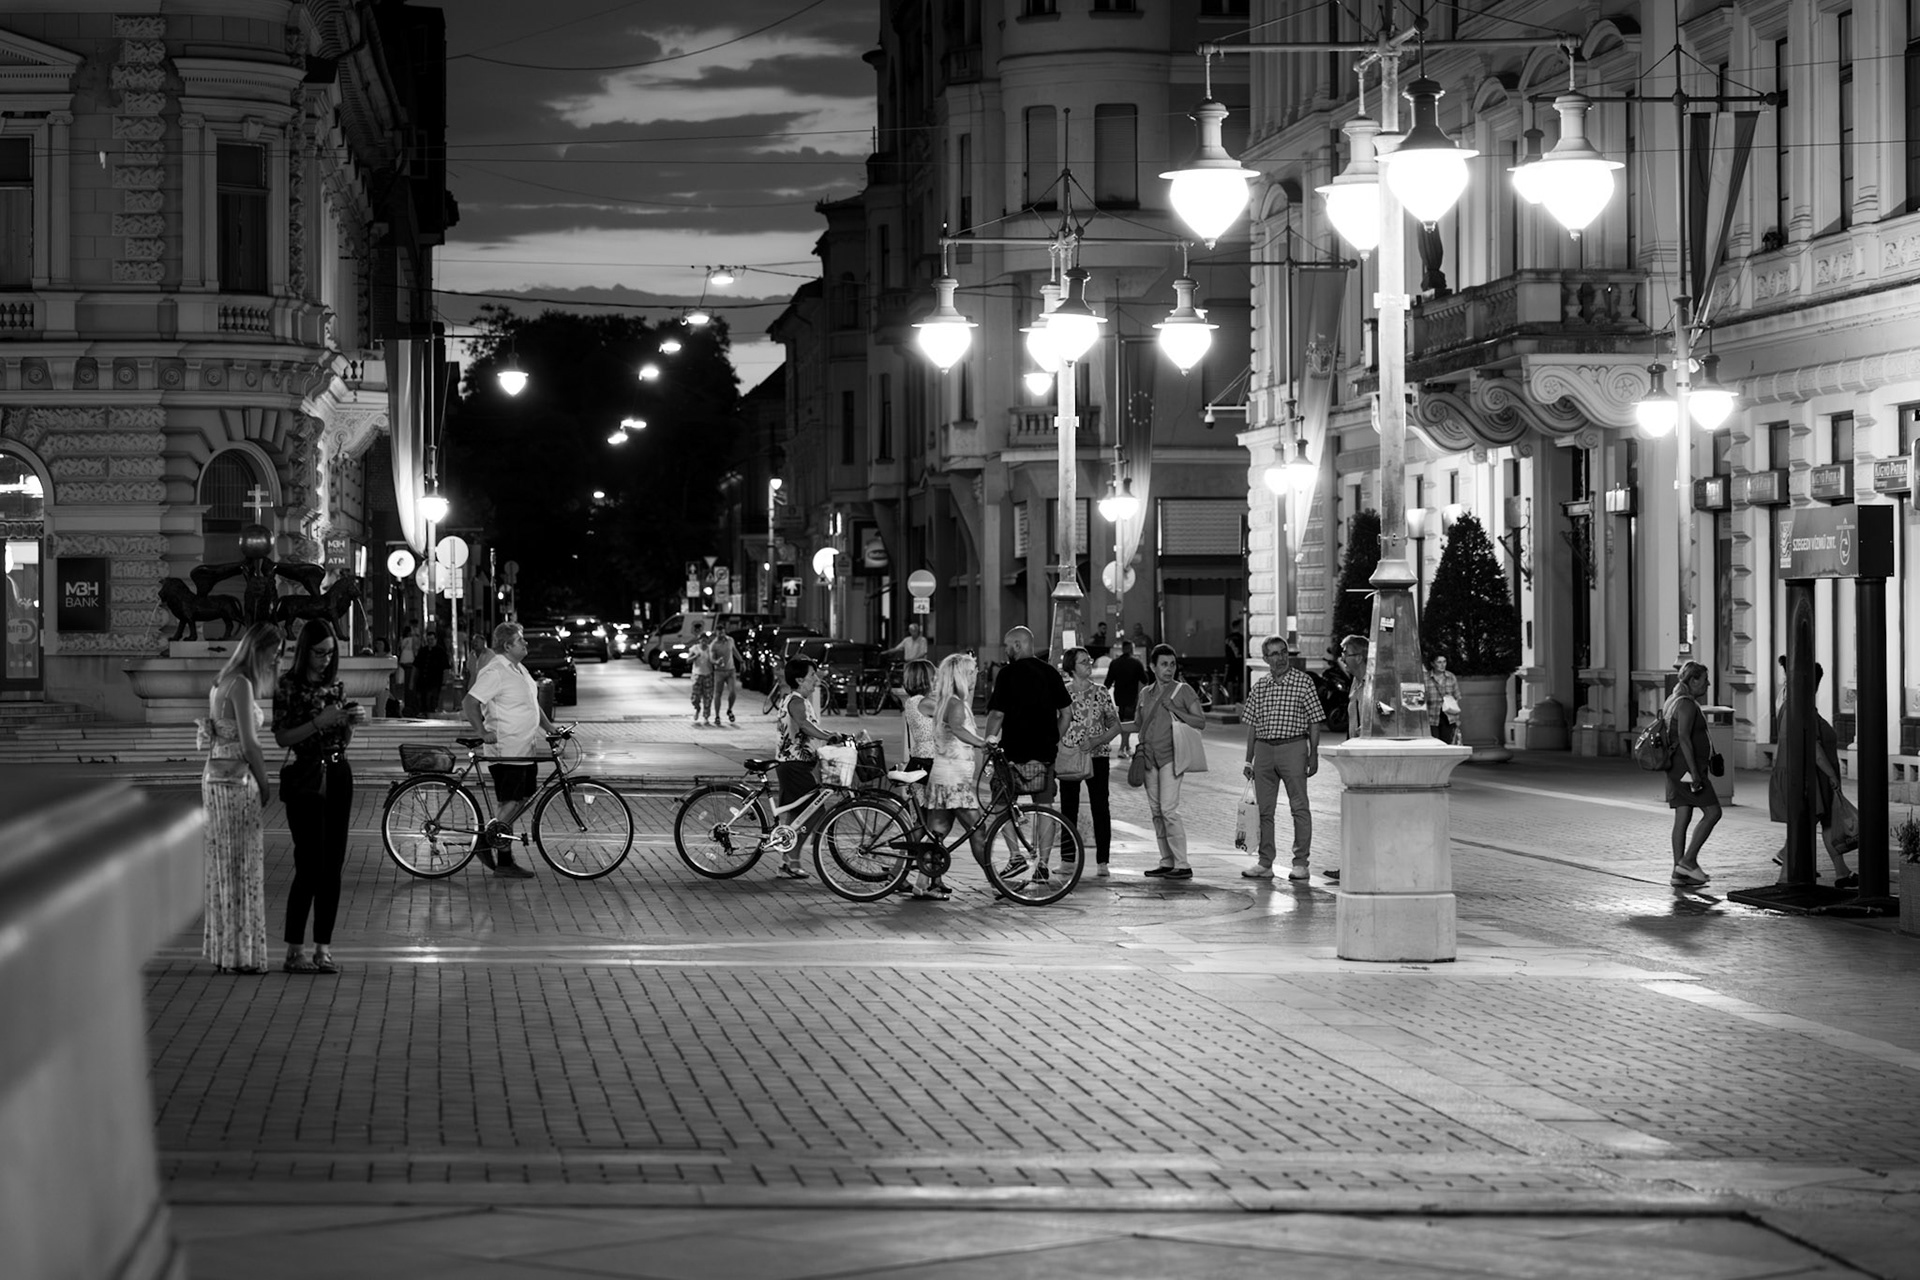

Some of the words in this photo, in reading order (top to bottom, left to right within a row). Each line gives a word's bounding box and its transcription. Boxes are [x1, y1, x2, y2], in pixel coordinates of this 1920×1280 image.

[1792, 538, 1811, 551] SZEGEDI
[328, 557, 345, 565] ATM
[65, 581, 99, 596] MBH
[65, 597, 99, 608] BANK
[8, 624, 28, 634] MFB
